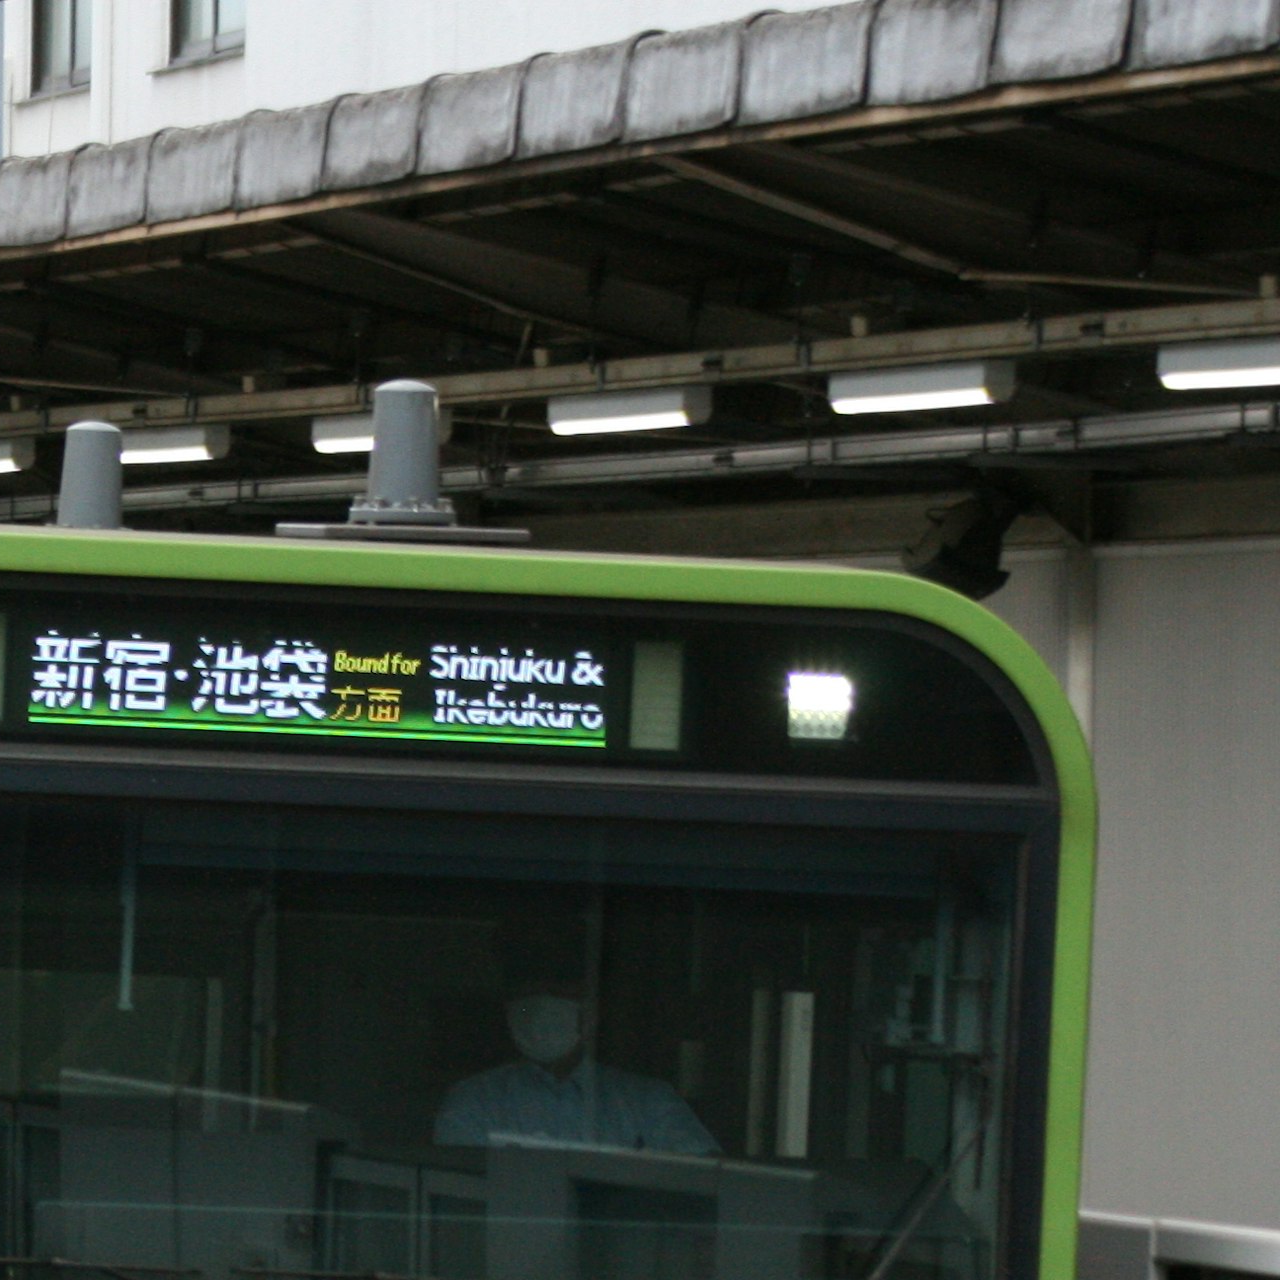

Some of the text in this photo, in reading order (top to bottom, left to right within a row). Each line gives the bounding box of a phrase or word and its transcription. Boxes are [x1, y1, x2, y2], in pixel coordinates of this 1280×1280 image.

[32, 629, 328, 720] 新宿・池袋
[334, 650, 421, 677] Bound for
[429, 645, 605, 687] Shinjuku &
[330, 685, 403, 722] 方面
[433, 684, 604, 730] Ikebukuro
